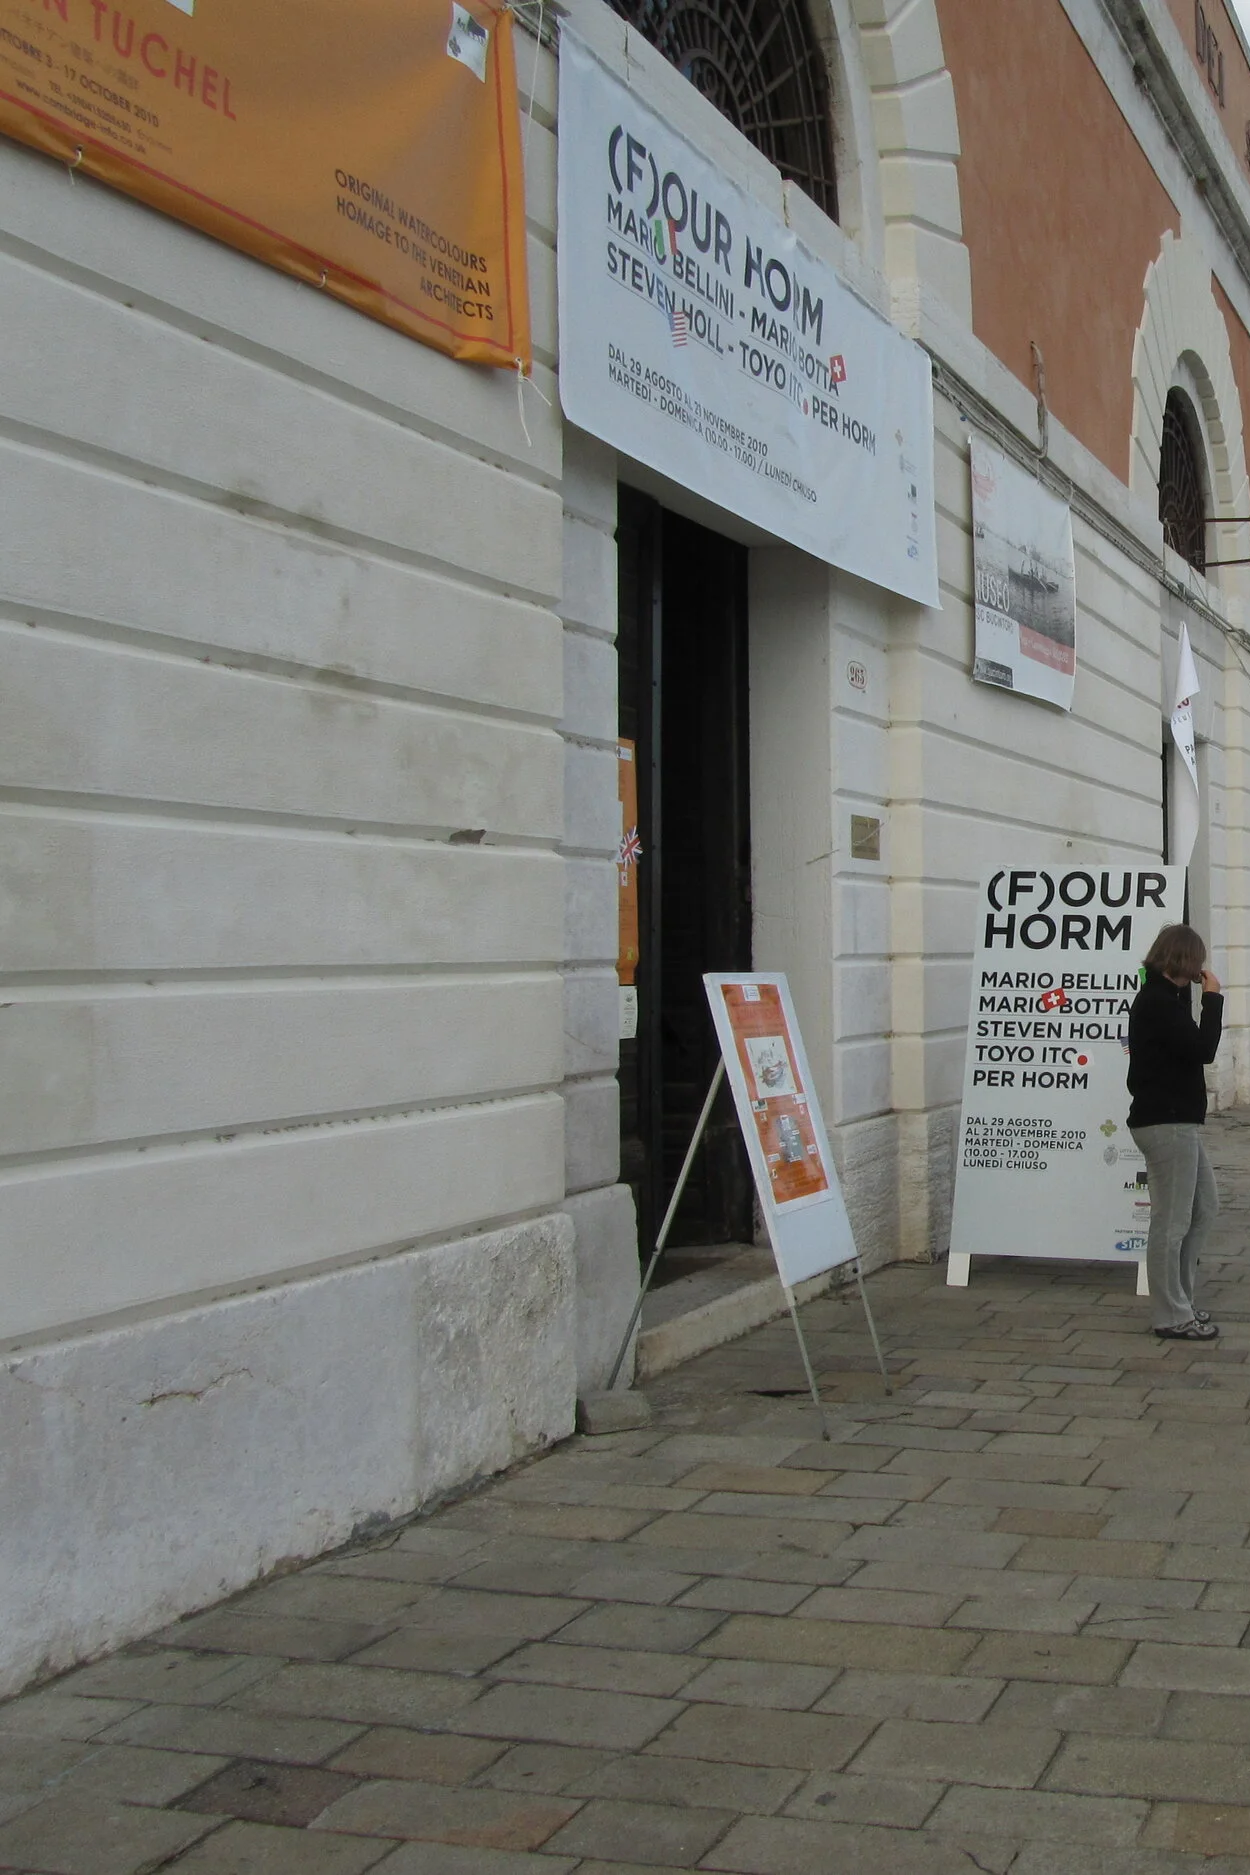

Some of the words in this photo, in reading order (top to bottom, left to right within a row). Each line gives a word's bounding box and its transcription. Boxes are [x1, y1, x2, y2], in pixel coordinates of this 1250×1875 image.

[91, 0, 237, 121] TUCHEL
[80, 74, 131, 112] OCTOBER
[134, 104, 159, 128] 2010
[335, 169, 395, 219] ORIGINAL
[398, 207, 488, 273] WATERCOLOURS
[608, 124, 732, 275] (F)OUR
[744, 235, 823, 346] HORM
[336, 195, 392, 244] HOMAGE
[394, 231, 409, 254] TO
[411, 242, 427, 268] THE
[429, 255, 490, 297] VENETIAN
[607, 192, 667, 265] MARIO
[673, 249, 734, 319] BELLINI
[751, 306, 799, 364] MARIO
[420, 276, 494, 321] ARCHITECTS
[607, 240, 676, 315] STEVEN
[682, 300, 724, 355] HOLL
[739, 340, 787, 391] TOYO
[812, 400, 839, 435] PER
[841, 412, 877, 457] HORM
[608, 343, 628, 369] DAL
[630, 356, 642, 377] 29
[644, 368, 684, 403] AGOSTO
[702, 407, 746, 446] NOVEMBRE
[747, 435, 768, 457] 2010
[660, 395, 704, 437] DOMENICA
[792, 478, 818, 503] CHIUSO
[987, 870, 1167, 913] (F)OUR
[984, 913, 1132, 951] HORM
[981, 971, 1054, 989] MARIO
[1061, 972, 1138, 991] BELLIN
[978, 995, 1050, 1014] MARIO
[1059, 997, 1131, 1015] BOTTA
[976, 1020, 1062, 1038] STEVEN
[1069, 1023, 1125, 1040] HOLL
[975, 1044, 1034, 1063] TOYO
[972, 1070, 1015, 1087] PER
[1021, 1071, 1088, 1089] HORM
[965, 1127, 980, 1136] AL
[982, 1128, 994, 1137] 21
[996, 1129, 1058, 1139] NOVEMBRE
[1060, 1130, 1086, 1140] 2010
[966, 1116, 988, 1126] DAL
[991, 1117, 1004, 1127] 29
[1007, 1118, 1053, 1128] AGOSTO
[964, 1137, 1014, 1148] MARTEDÌ
[1023, 1139, 1084, 1150] DOMENICA
[964, 1148, 998, 1159] (10.00
[1007, 1149, 1040, 1160] 17.00)
[963, 1158, 1003, 1168] LUNEDÌ
[1006, 1160, 1048, 1170] CHIUSO
